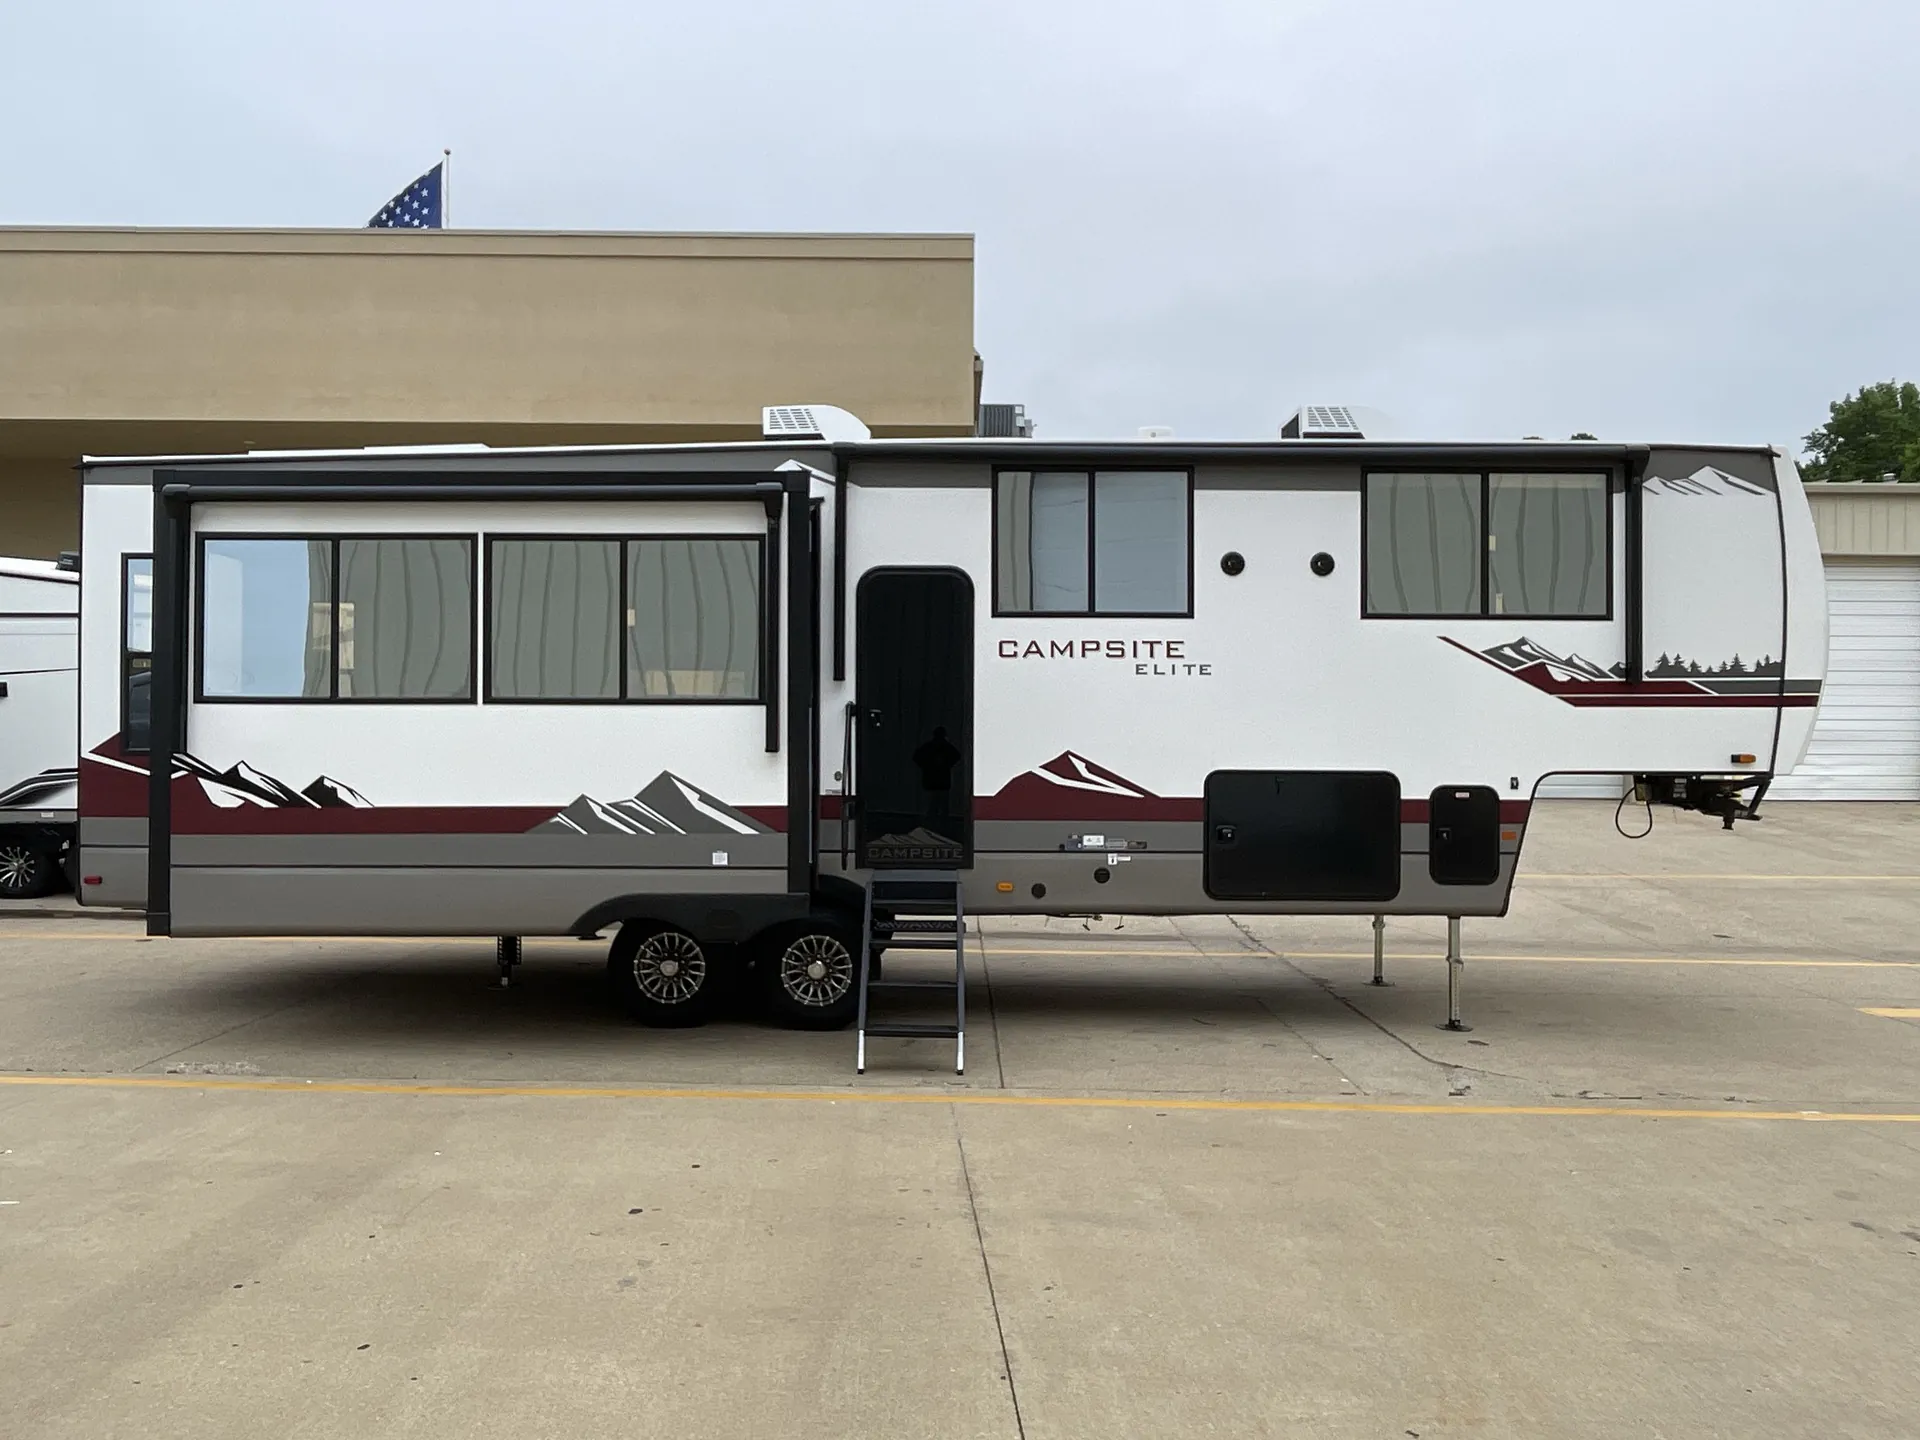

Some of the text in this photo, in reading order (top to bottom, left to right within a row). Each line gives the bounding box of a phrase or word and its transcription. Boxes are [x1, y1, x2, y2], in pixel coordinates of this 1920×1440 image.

[998, 640, 1186, 659] CAMPSITE
[1135, 664, 1212, 676] ELITE
[867, 848, 965, 859] CAMPSITE
